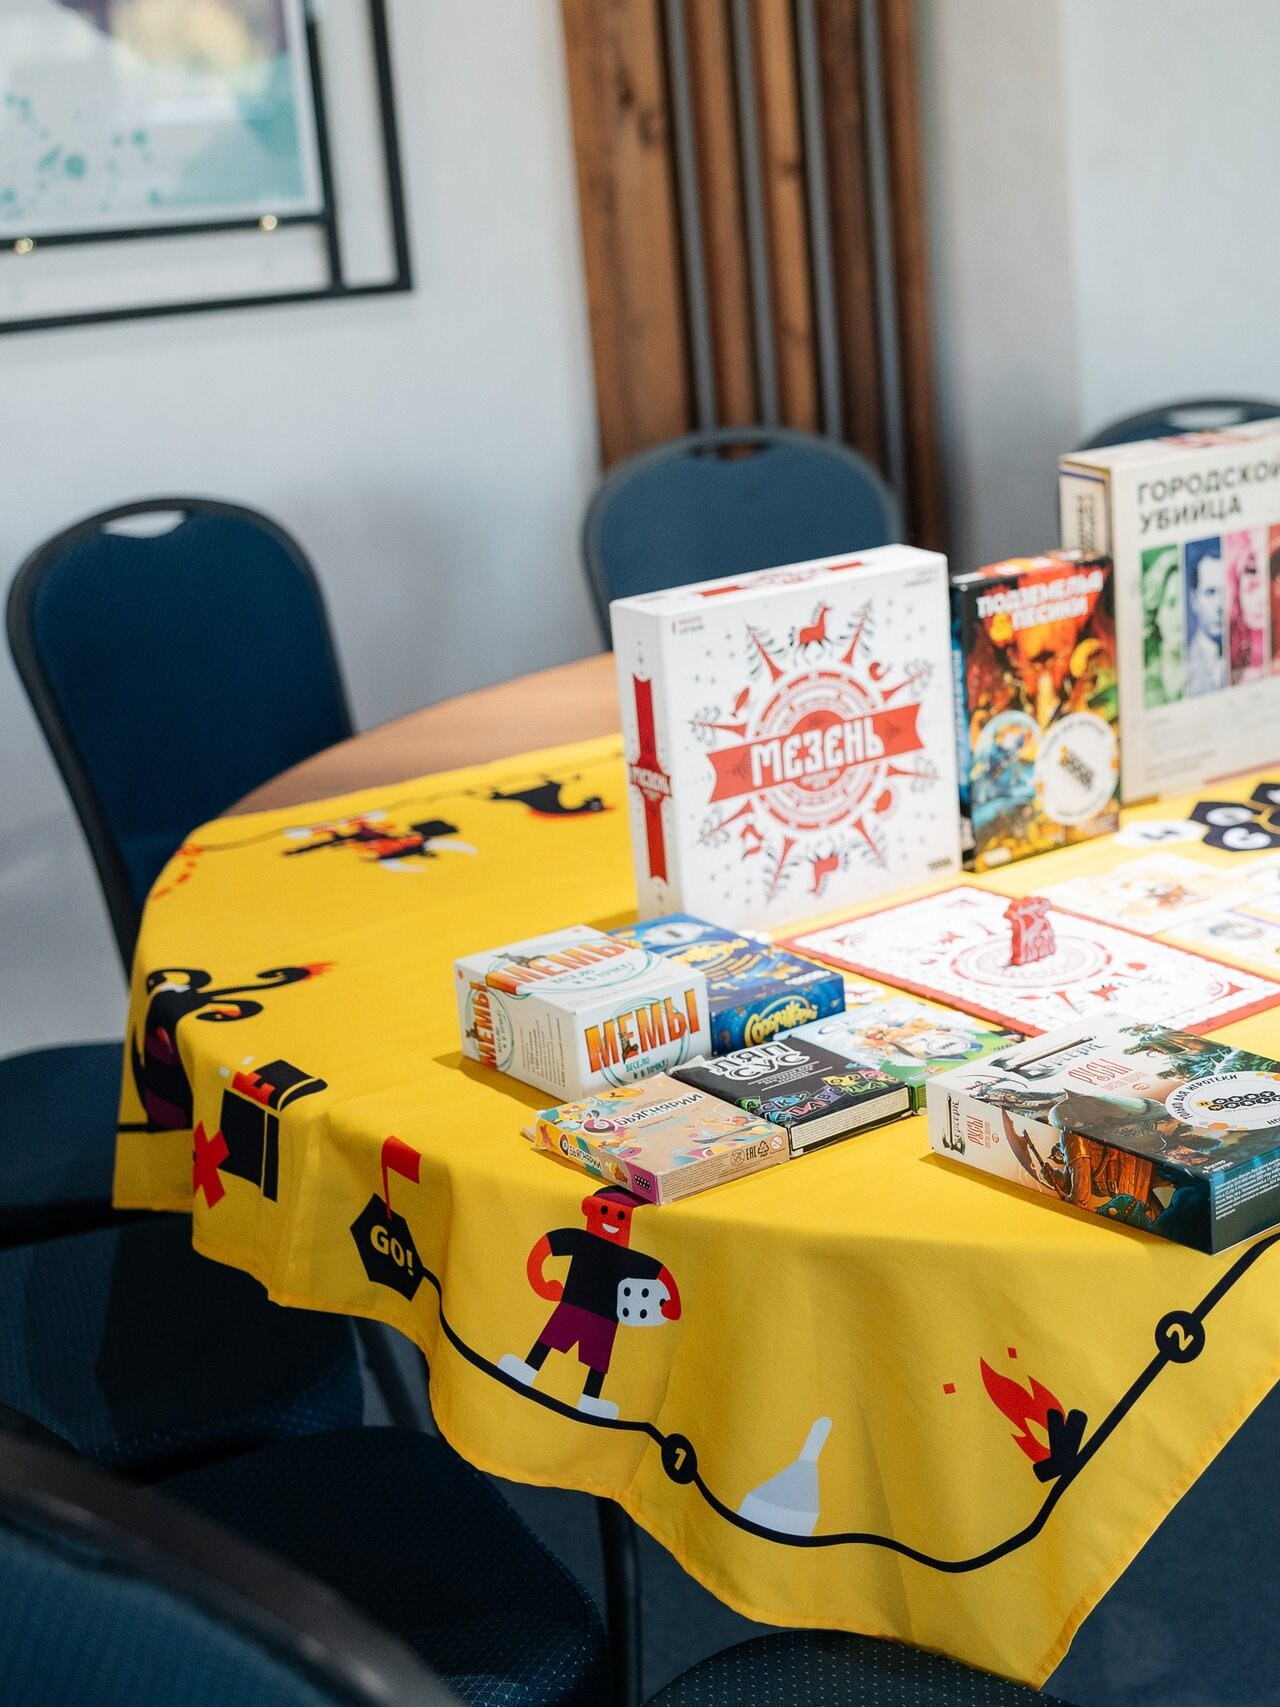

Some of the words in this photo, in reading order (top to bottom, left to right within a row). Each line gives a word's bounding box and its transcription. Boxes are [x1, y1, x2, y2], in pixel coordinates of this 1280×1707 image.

[1138, 496, 1243, 535] УБИЙЦА
[975, 570, 1104, 619] ПОДЗЕМЕЛЬЯ
[750, 717, 885, 788] МЕЗЕНЬ
[485, 935, 645, 995] МЕМЫ
[469, 980, 498, 1071] МЕМЫ
[584, 988, 700, 1073] МЕМЫ
[626, 1057, 650, 1072] ВЕСЕЛО
[1173, 1090, 1190, 1102] ДЛЯ
[1186, 1074, 1238, 1091] ИГРОТЕКИ
[1197, 1091, 1275, 1107] HOBBY
[1171, 1101, 1193, 1120] ТОЛЬКО
[369, 1224, 414, 1276] GO!
[1165, 1323, 1194, 1351] 2
[673, 1446, 687, 1470] 1
